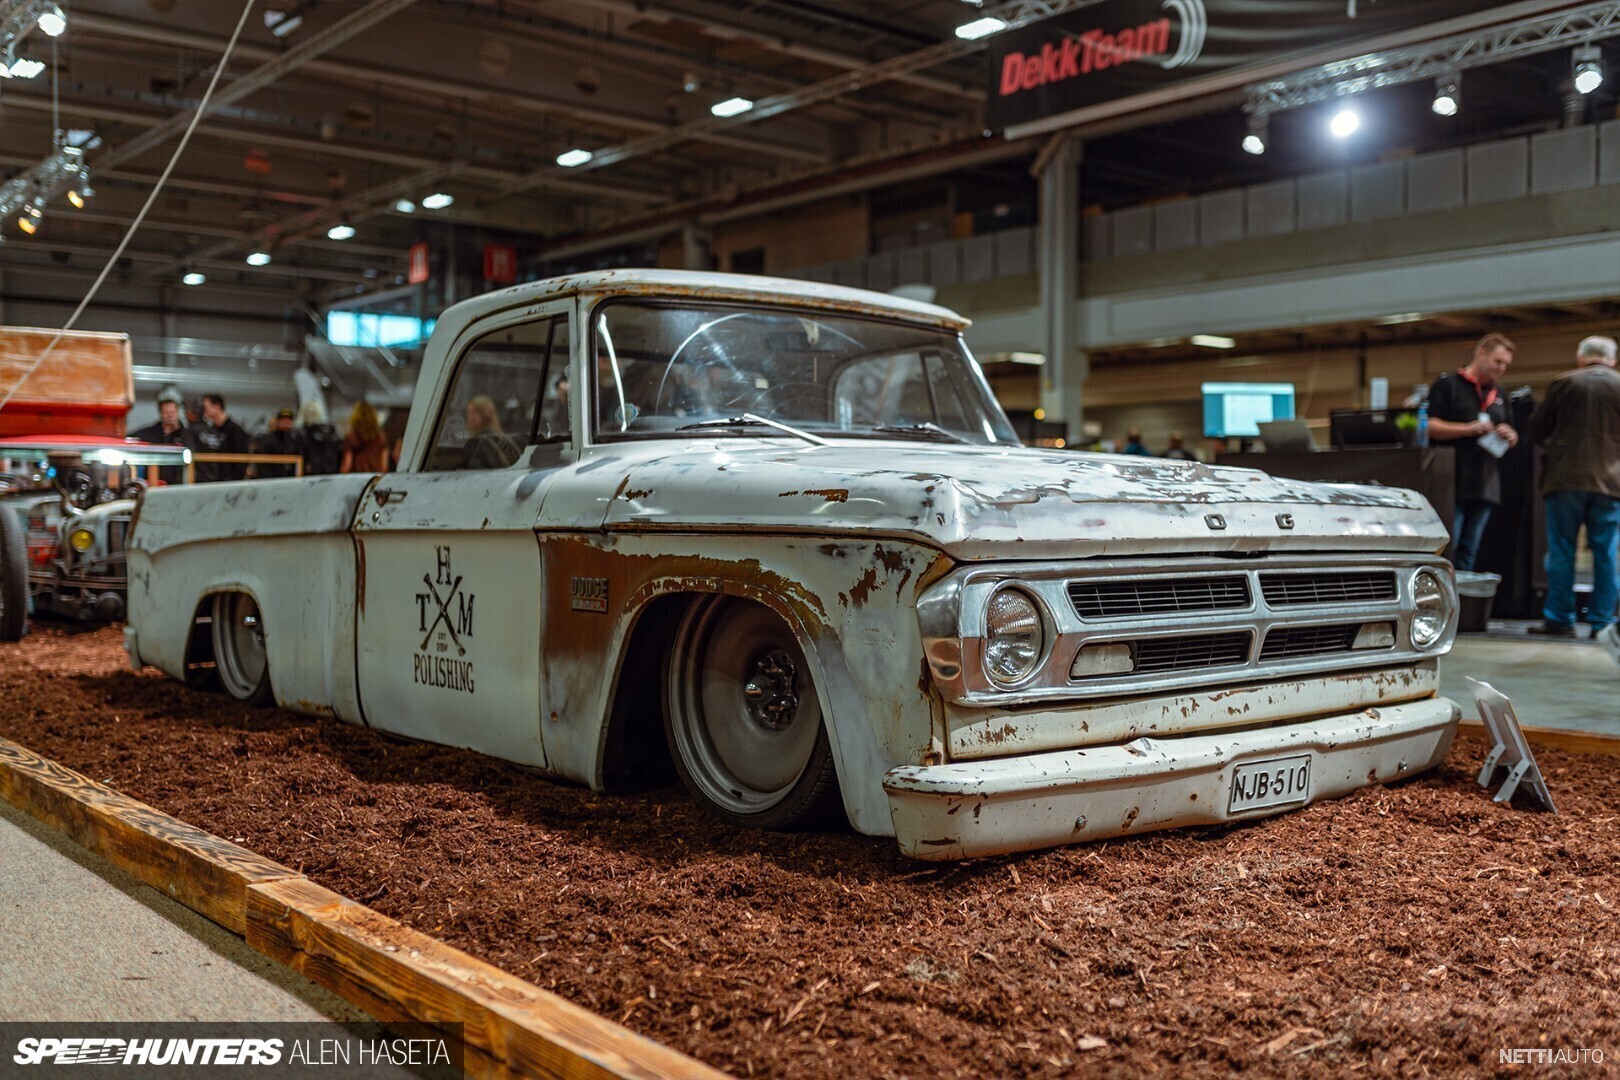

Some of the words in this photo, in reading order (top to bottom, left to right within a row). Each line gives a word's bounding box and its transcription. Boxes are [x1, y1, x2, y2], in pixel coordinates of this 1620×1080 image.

[999, 18, 1171, 97] DekkTeam
[434, 545, 452, 585] H
[571, 576, 609, 598] DODGE
[415, 593, 430, 632] T
[457, 591, 475, 637] M
[413, 653, 475, 694] POLISHING
[1232, 765, 1307, 803] NJB-510
